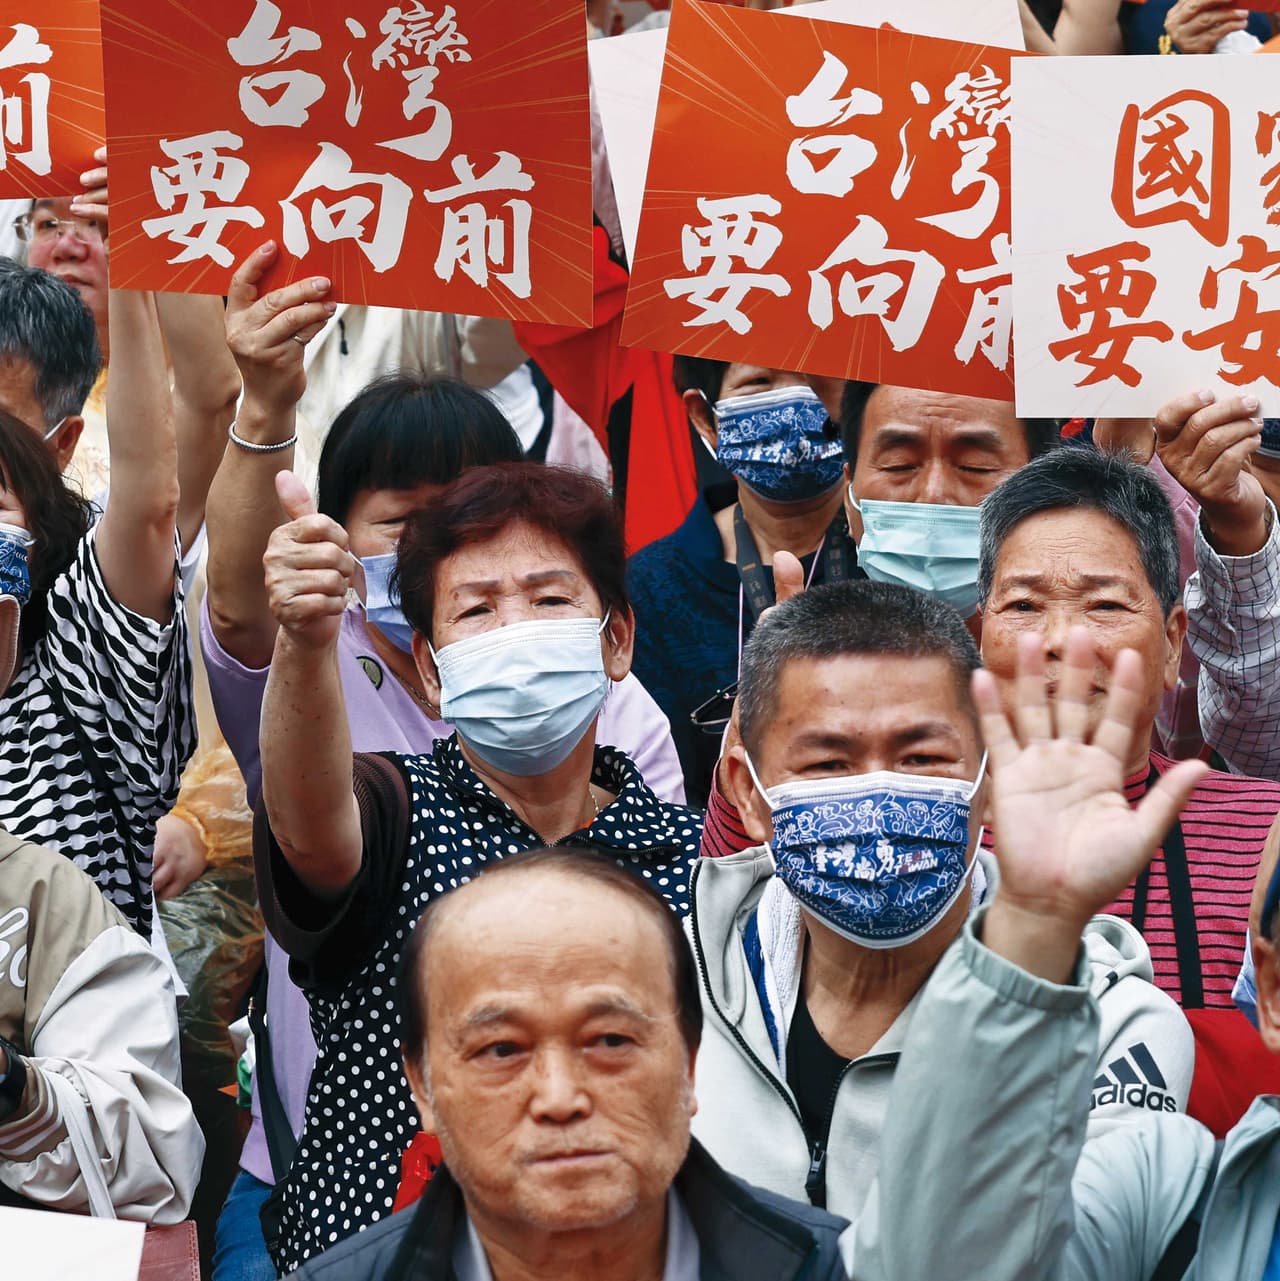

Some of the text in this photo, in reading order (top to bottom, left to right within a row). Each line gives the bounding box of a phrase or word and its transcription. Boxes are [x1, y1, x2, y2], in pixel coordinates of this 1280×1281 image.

[141, 130, 535, 299] 要向前
[785, 50, 1013, 240] 台灣
